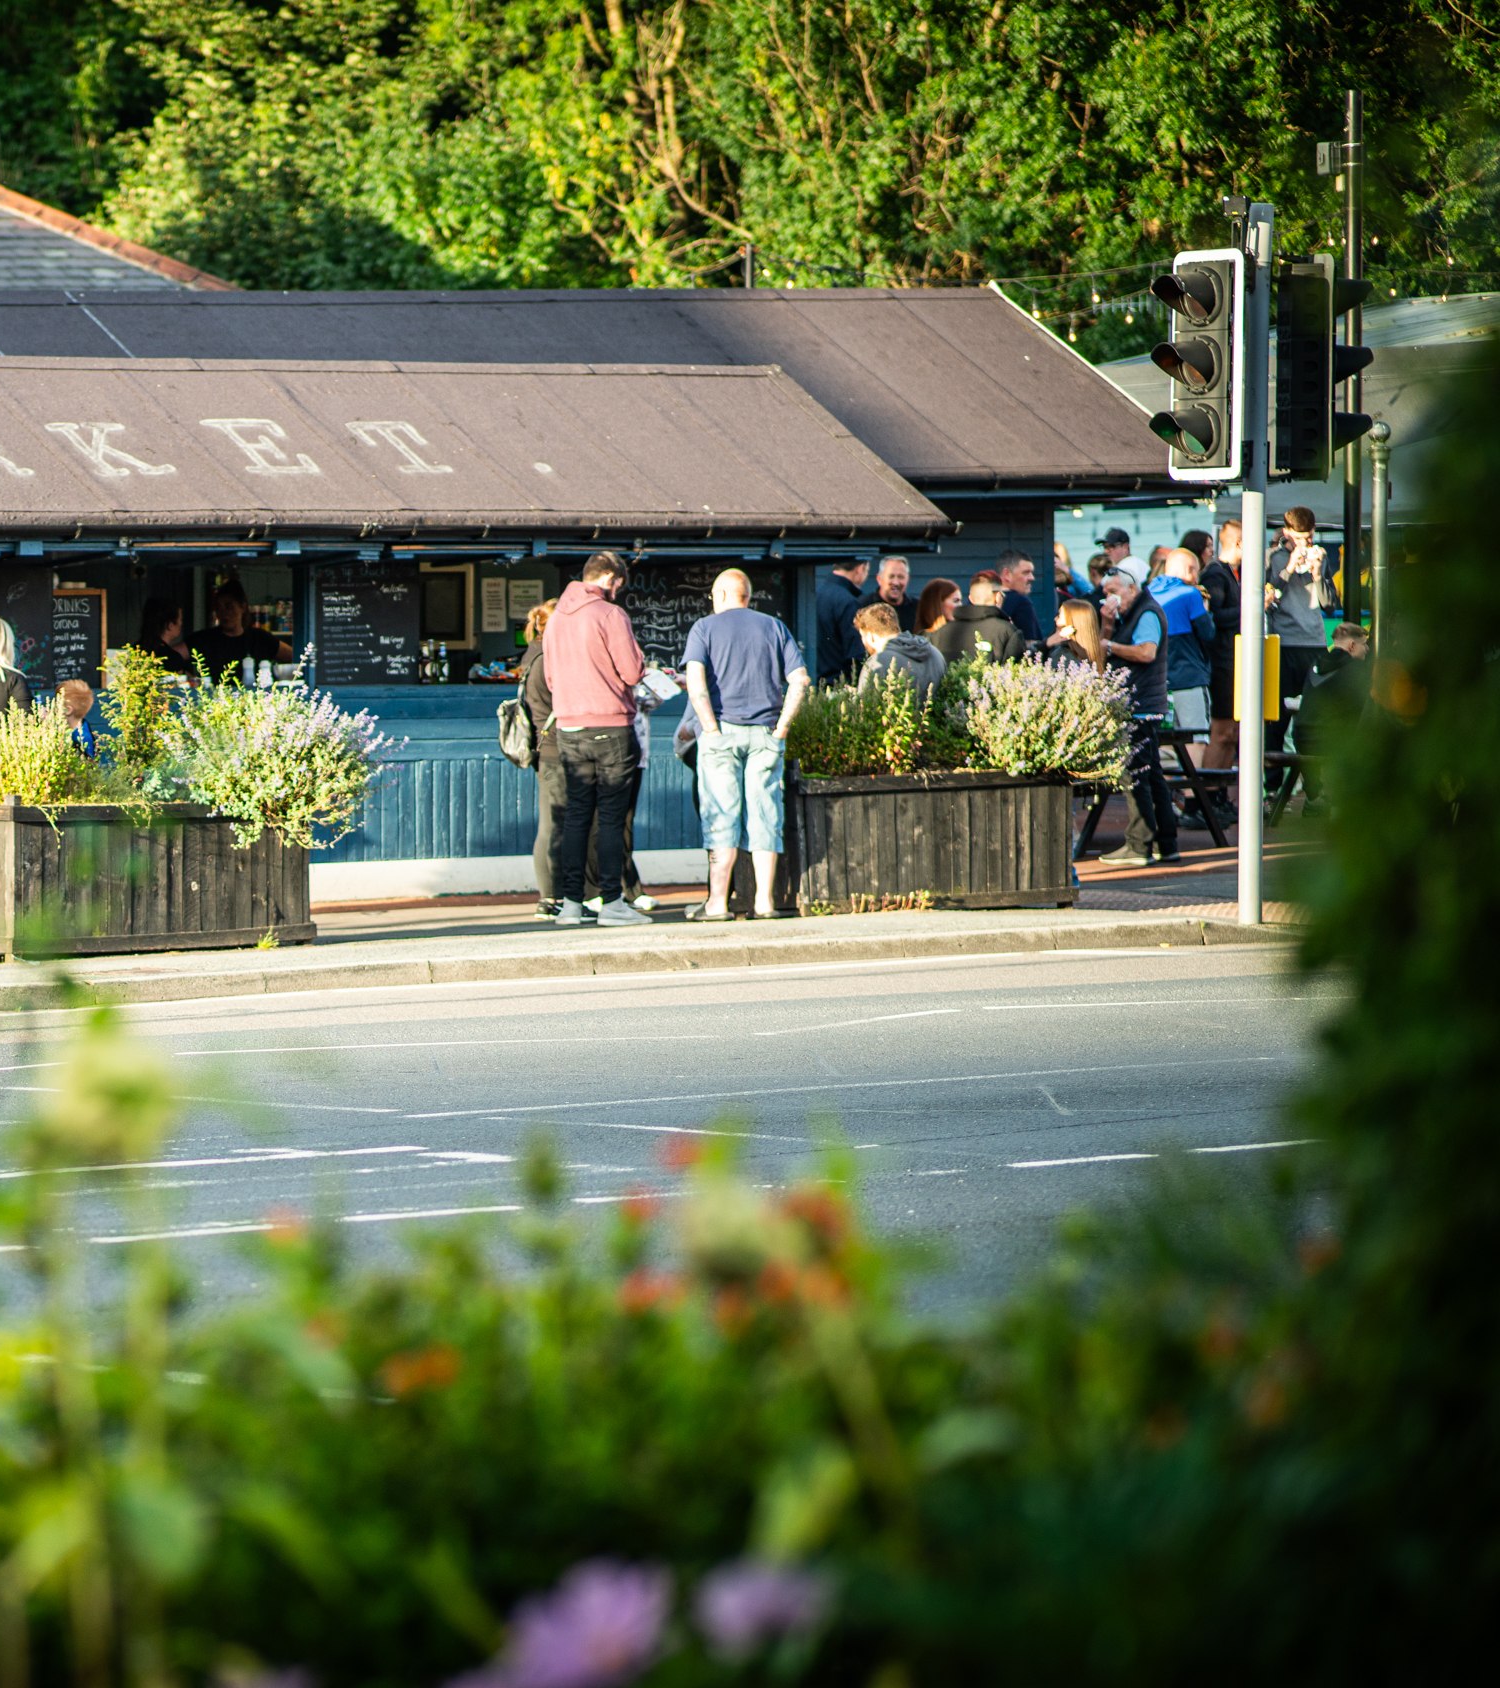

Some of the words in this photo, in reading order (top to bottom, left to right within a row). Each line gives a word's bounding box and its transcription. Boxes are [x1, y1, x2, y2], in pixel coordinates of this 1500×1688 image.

[52, 618, 80, 631] orona
[630, 614, 649, 625] eese
[53, 645, 68, 656] arge
